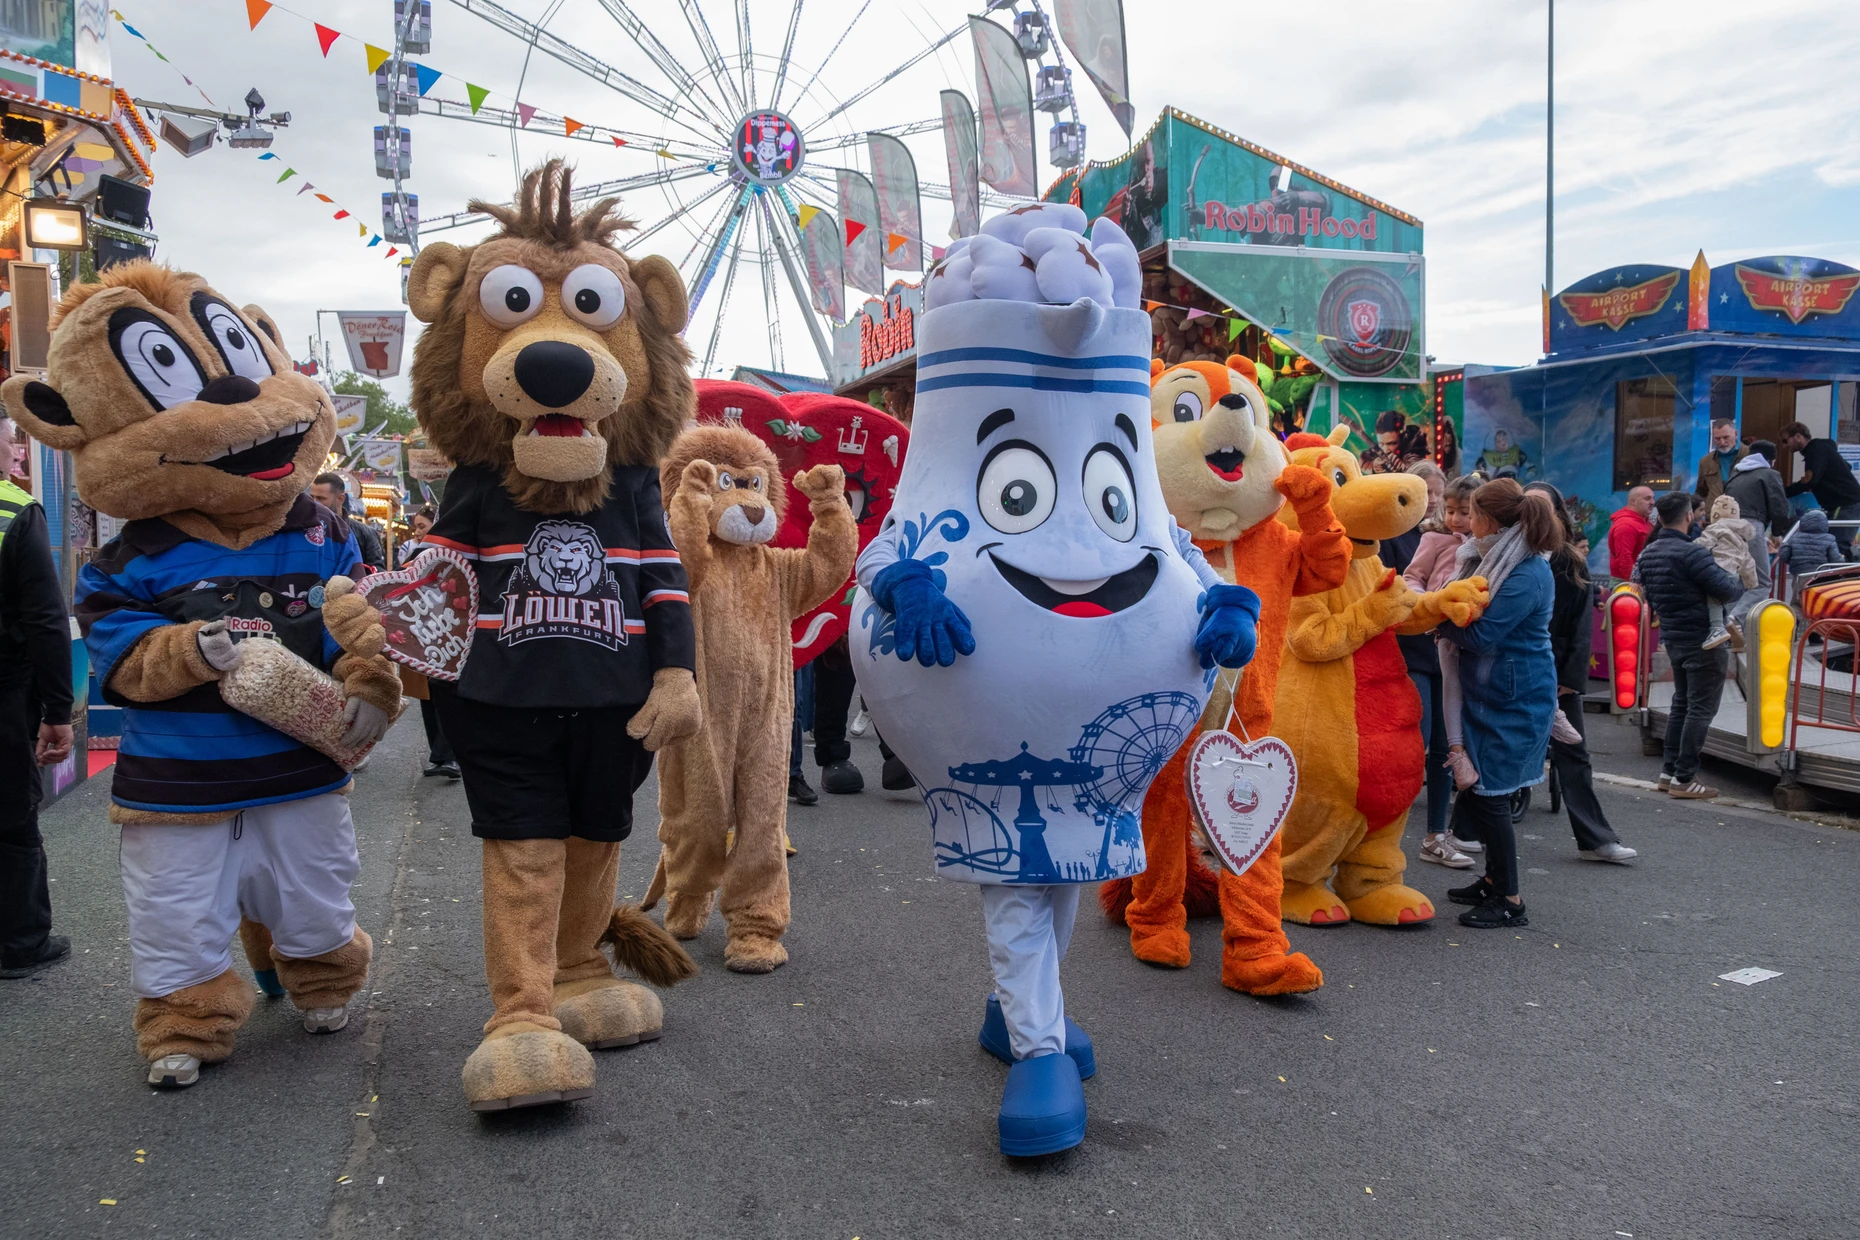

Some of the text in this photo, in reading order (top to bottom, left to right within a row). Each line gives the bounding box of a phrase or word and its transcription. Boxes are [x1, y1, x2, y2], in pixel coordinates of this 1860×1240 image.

[1204, 200, 1377, 240] Robin Hood
[1770, 281, 1831, 295] AIRPORT
[1590, 288, 1647, 308] AIRPORT
[1782, 294, 1818, 308] KASSE
[1602, 302, 1636, 317] KASSE
[1360, 315, 1370, 326] R
[860, 294, 914, 369] Robin
[503, 591, 624, 640] LÖWEN
[232, 617, 272, 632] Radio
[515, 625, 612, 642] FRANKFURT
